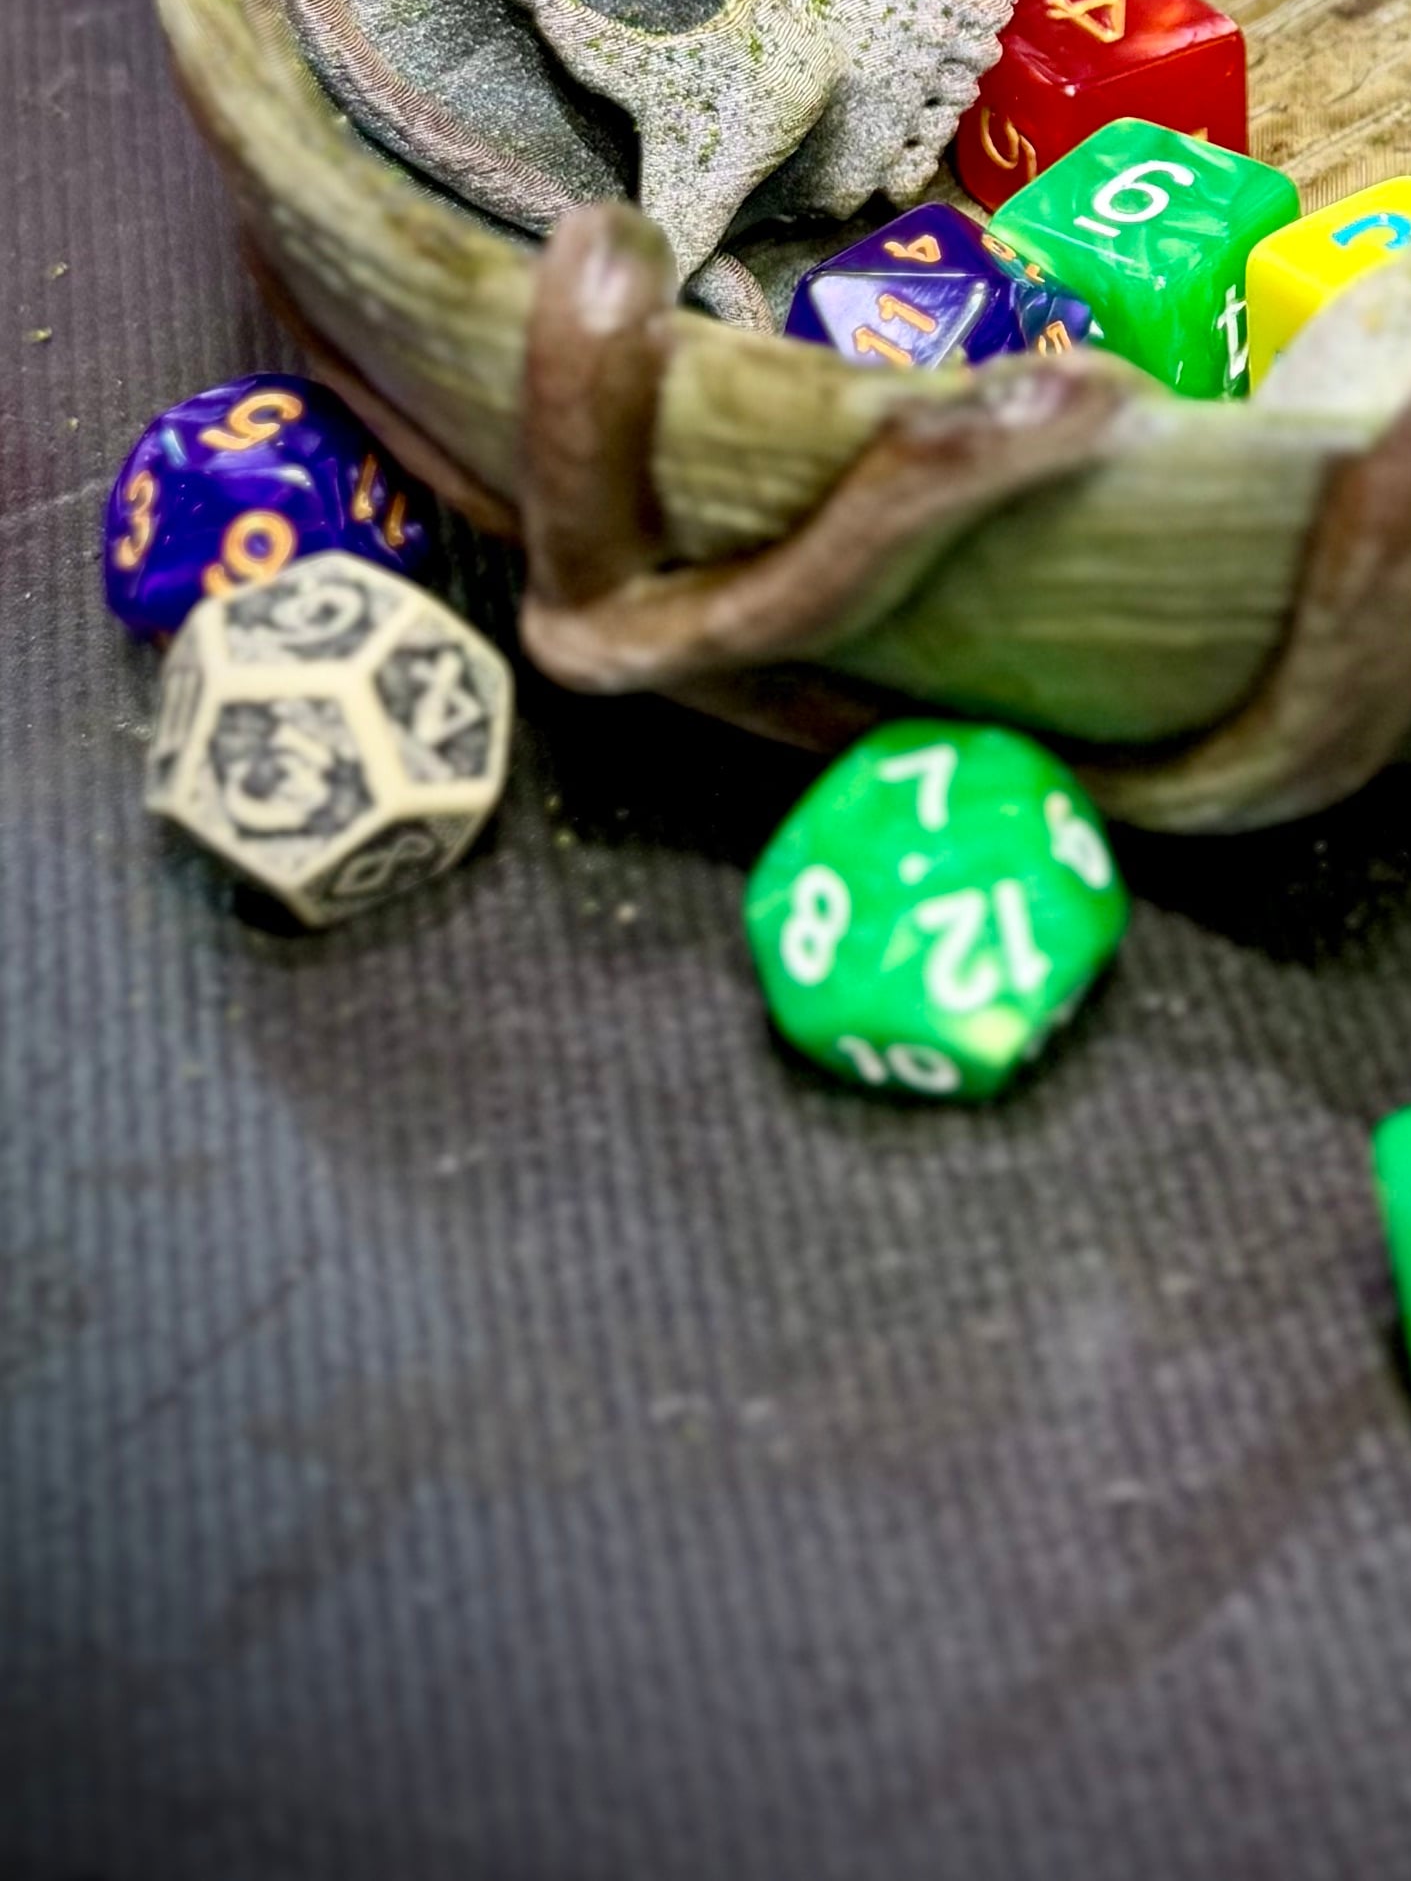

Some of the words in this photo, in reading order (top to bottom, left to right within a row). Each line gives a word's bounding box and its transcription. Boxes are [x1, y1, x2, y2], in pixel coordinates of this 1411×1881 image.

[199, 393, 303, 451] 5
[115, 472, 158, 570] 3
[878, 743, 958, 831] 7
[779, 864, 851, 986] 8
[915, 879, 1052, 1014] 12
[837, 1034, 960, 1093] 10
